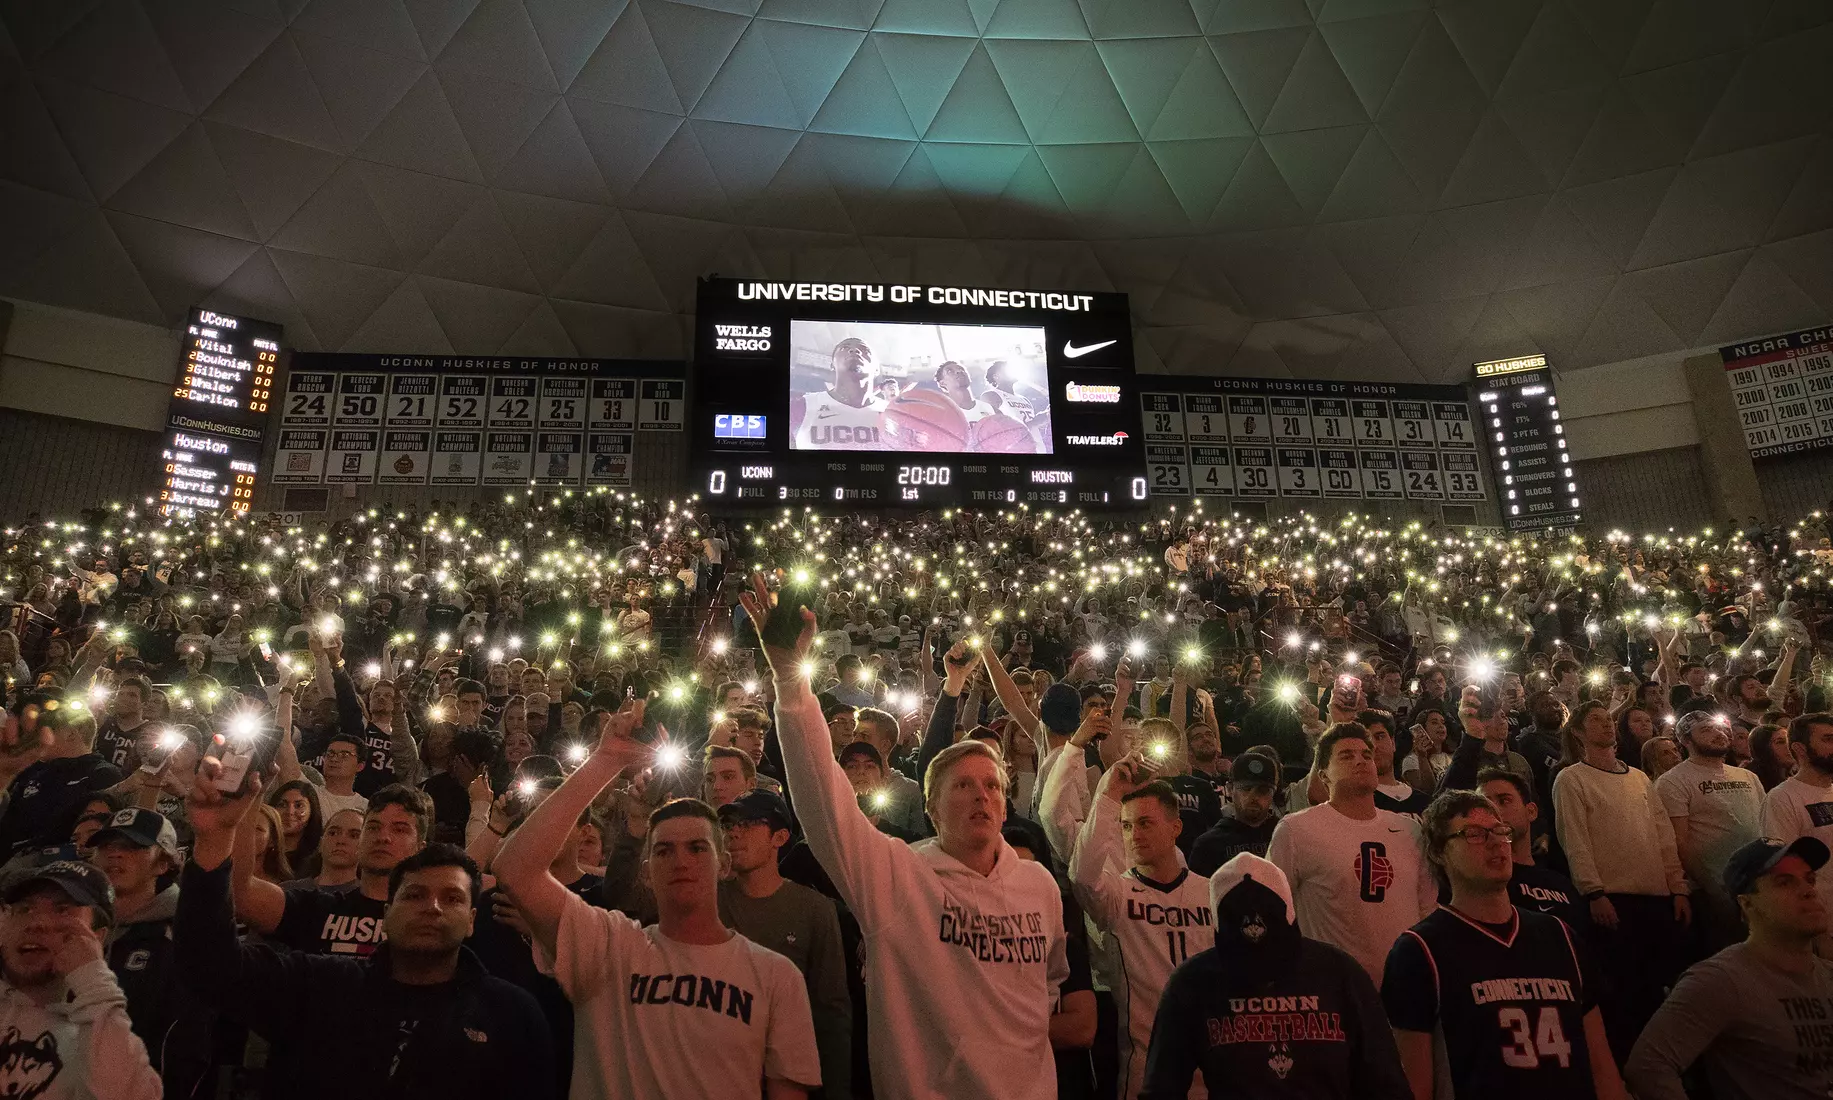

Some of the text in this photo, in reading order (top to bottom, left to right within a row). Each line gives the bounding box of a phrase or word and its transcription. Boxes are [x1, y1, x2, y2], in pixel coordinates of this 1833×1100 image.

[738, 283, 1094, 312] UNIVERSITY OF CONNECTICUT
[200, 311, 237, 329] UConn
[715, 325, 772, 337] WELLS
[199, 339, 233, 354] Vital
[716, 338, 770, 351] FARGO
[1735, 339, 1790, 357] NCAA
[187, 364, 241, 381] 3 Gilbert
[381, 358, 599, 371] UCONN HUSKIES OF HONOR
[1477, 357, 1546, 375] GO HUSKIES
[1767, 356, 1831, 379] 1994 1995
[184, 377, 233, 393] 5 Whaley
[1489, 374, 1540, 388] STAT BOARD
[1733, 370, 1758, 385] 1991
[1214, 380, 1396, 394] UCONN HUSKIES OF HONOR
[1737, 383, 1801, 405] 2000 2001
[174, 388, 238, 408] 25 Carlton
[290, 395, 326, 415] 24
[342, 396, 377, 416] 50
[397, 396, 425, 417] 21
[447, 398, 477, 418] 52
[496, 398, 529, 418] 42
[551, 399, 575, 419] 25
[604, 401, 622, 420] 33
[654, 401, 669, 421] 10
[1743, 403, 1807, 425] 2007 2008
[716, 415, 760, 429] CBS
[1154, 414, 1171, 432] 32
[1202, 415, 1211, 433] 3
[1283, 417, 1300, 436] 20
[1325, 418, 1340, 437] 31
[1364, 419, 1382, 438] 23
[1404, 421, 1423, 440] 31
[1444, 422, 1464, 440] 14
[1067, 436, 1118, 446] TRAVELERS
[1519, 430, 1528, 438] PT
[1749, 423, 1812, 445] 2014 2015
[174, 433, 228, 454] Houston
[1511, 443, 1548, 454] REBOUNDS
[828, 463, 885, 472] POSS BONUS
[963, 465, 987, 473] BONUS
[1518, 457, 1546, 467] ASSISTS
[173, 464, 217, 479] Sasser
[742, 467, 772, 479] UCONN
[899, 467, 950, 484] 20:00
[1032, 471, 1072, 483] HOUSTON
[1154, 466, 1180, 486] 23
[1206, 467, 1218, 486] 4
[1243, 468, 1268, 488] 30
[1292, 468, 1305, 488] 3
[1328, 470, 1352, 489] CD
[1372, 471, 1391, 490] 15
[1515, 471, 1555, 483] TURNOVERS
[171, 478, 215, 493] Harris
[220, 485, 229, 496] J
[710, 471, 726, 494] 0
[1133, 478, 1145, 499] 0
[1409, 472, 1439, 491] 24
[1450, 473, 1478, 491] 33
[738, 487, 877, 499] 1 FULL 3 30 SEC 0 TM FLS
[902, 487, 919, 499] 1st
[972, 490, 1108, 502] TM FLS 0 30 SEC 3 FULL 1
[1525, 487, 1552, 497] BLOCKS
[1529, 502, 1554, 512] STEALS
[1026, 912, 1042, 933] OF
[630, 973, 754, 1025] UCONN
[1470, 977, 1576, 1005] CONNECTICUT
[1778, 998, 1826, 1020] THIS
[1206, 1012, 1346, 1046] BASKETBALL
[1498, 1006, 1571, 1069] 34
